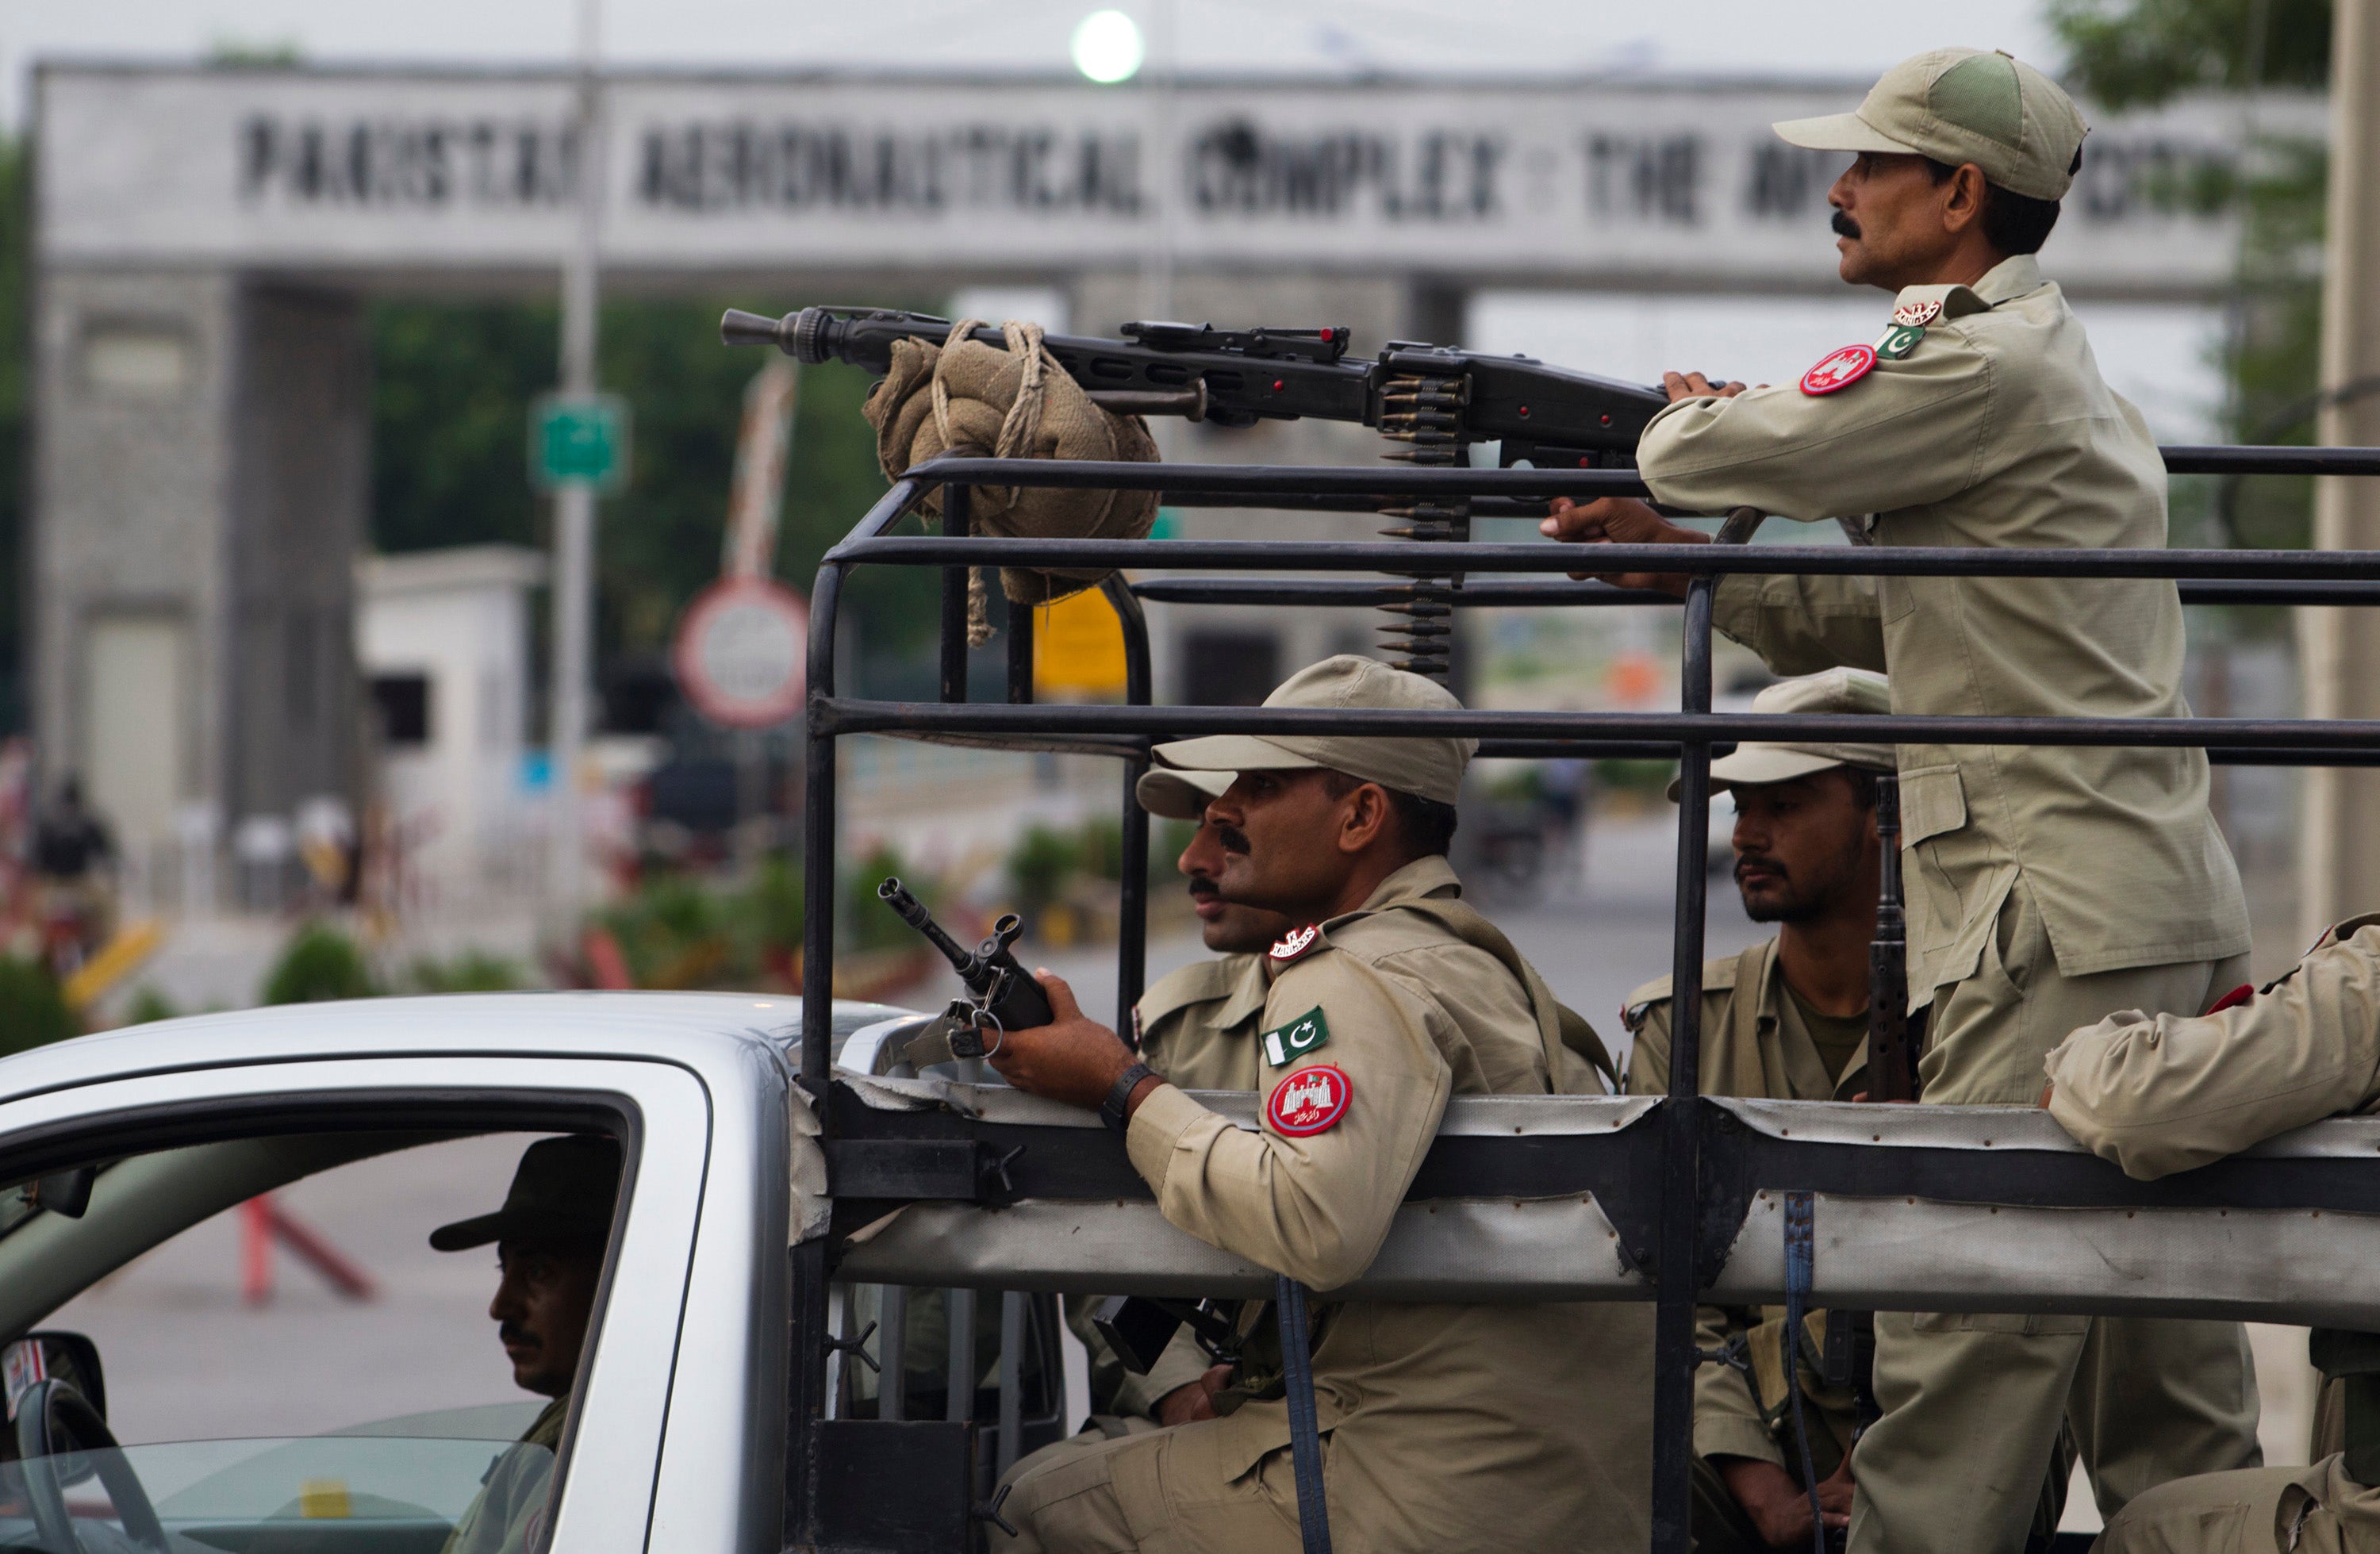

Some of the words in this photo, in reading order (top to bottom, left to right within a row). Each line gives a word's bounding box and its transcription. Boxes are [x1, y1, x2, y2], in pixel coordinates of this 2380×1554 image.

[639, 125, 1147, 213] AERONAUTICAL
[1193, 121, 1506, 219] COMPLEX
[1585, 130, 1704, 225] THE
[1894, 301, 1940, 327] RANGERS
[1269, 926, 1316, 958] RANGERS
